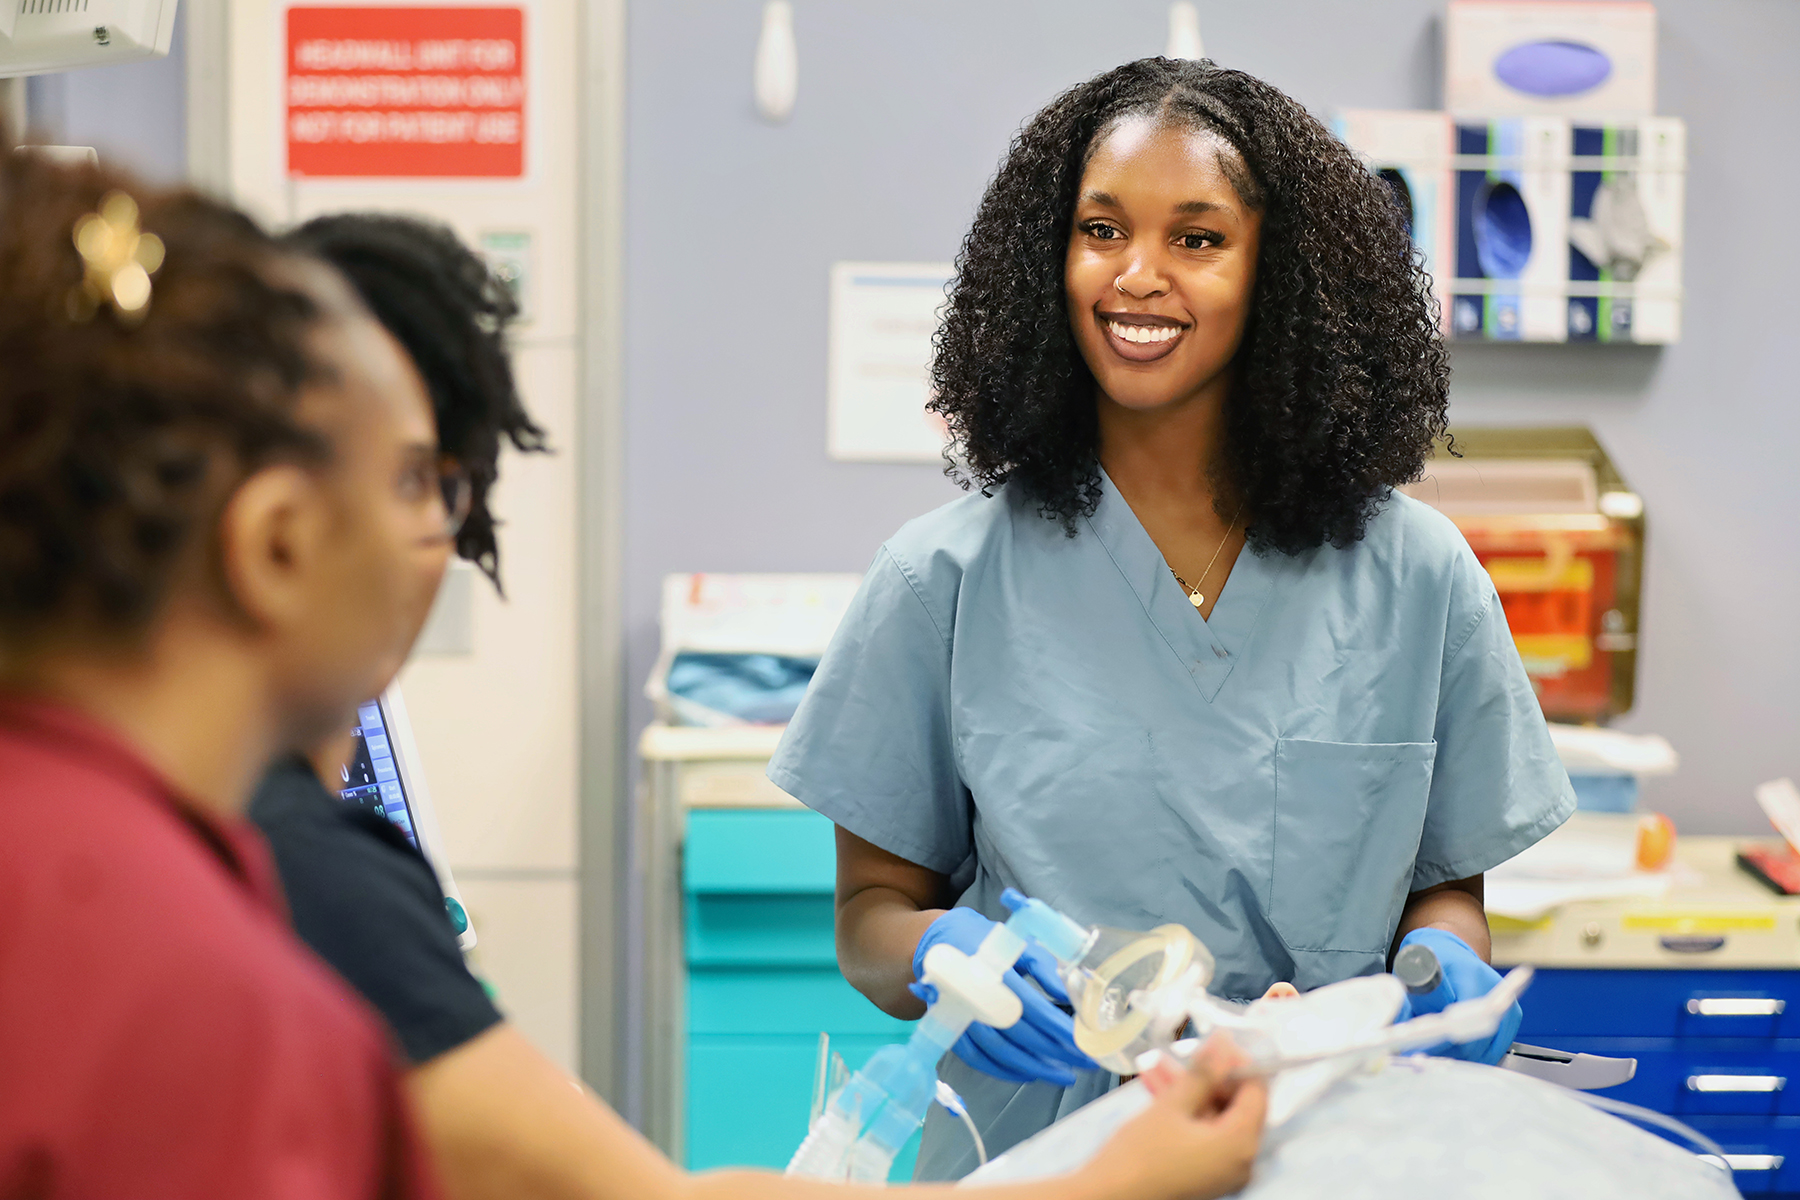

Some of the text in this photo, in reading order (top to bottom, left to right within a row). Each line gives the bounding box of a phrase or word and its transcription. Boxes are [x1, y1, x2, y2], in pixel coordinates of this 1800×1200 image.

[297, 40, 412, 69] HEADWALL
[467, 40, 515, 69] FOR
[289, 76, 462, 106] DEMONSTRATION
[293, 112, 518, 142] NOT FOR PATIENT USE
